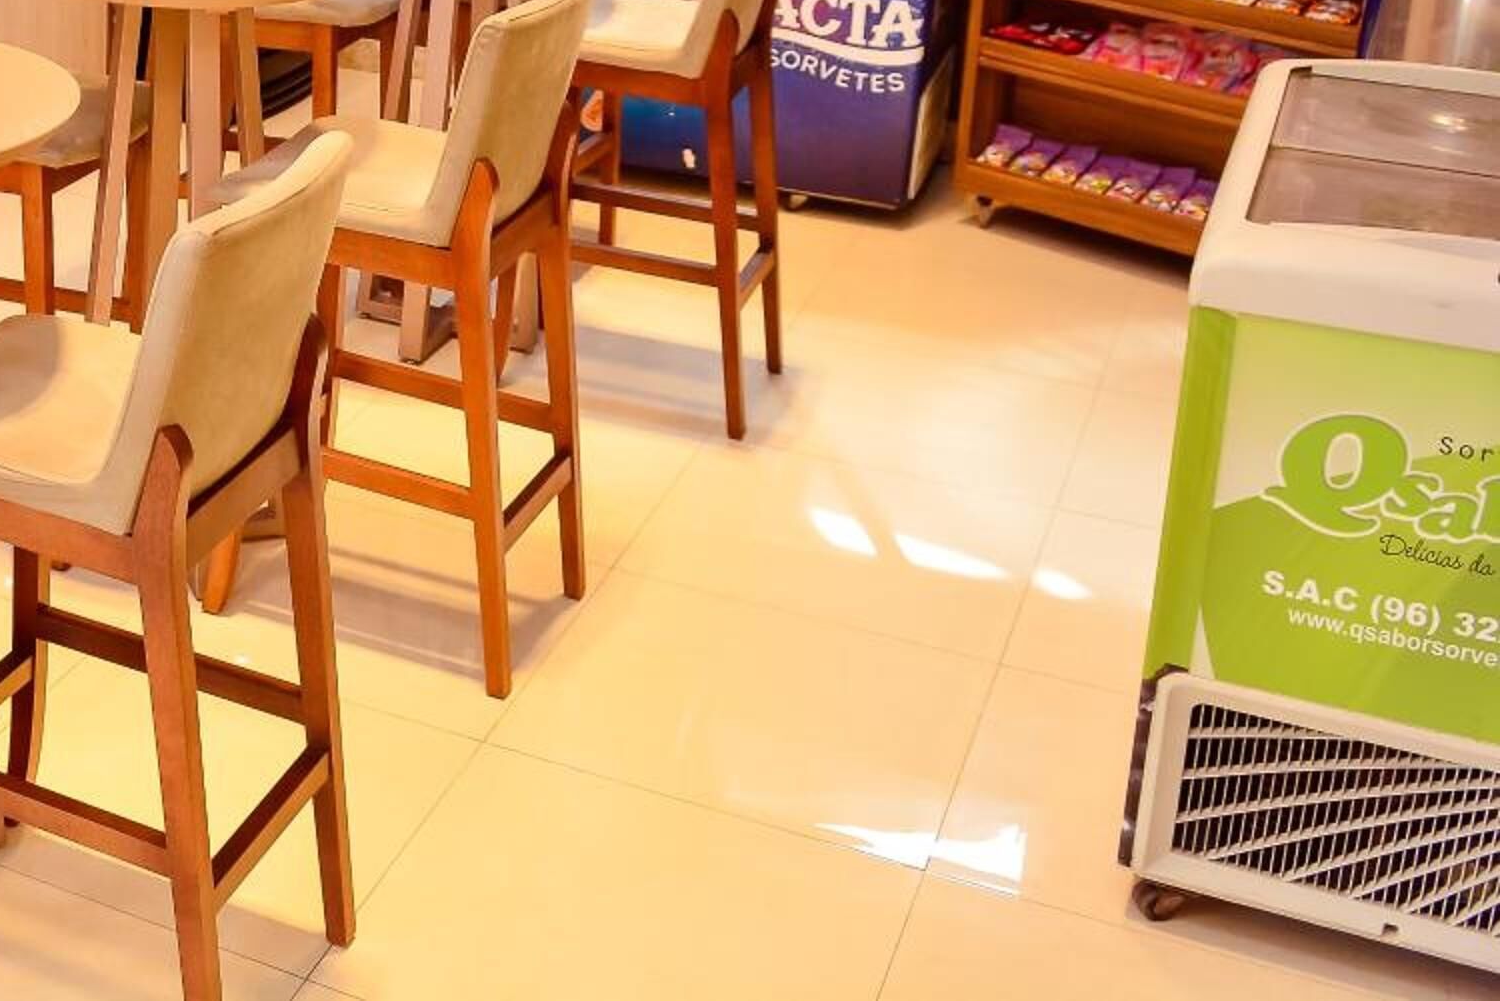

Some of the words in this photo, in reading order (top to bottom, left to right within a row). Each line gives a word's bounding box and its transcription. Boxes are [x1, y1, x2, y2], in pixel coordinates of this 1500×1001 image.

[769, 48, 905, 93] SORVETES
[1469, 552, 1497, 576] da
[1261, 570, 1359, 612] S.A.C
[1371, 594, 1441, 636] (96)
